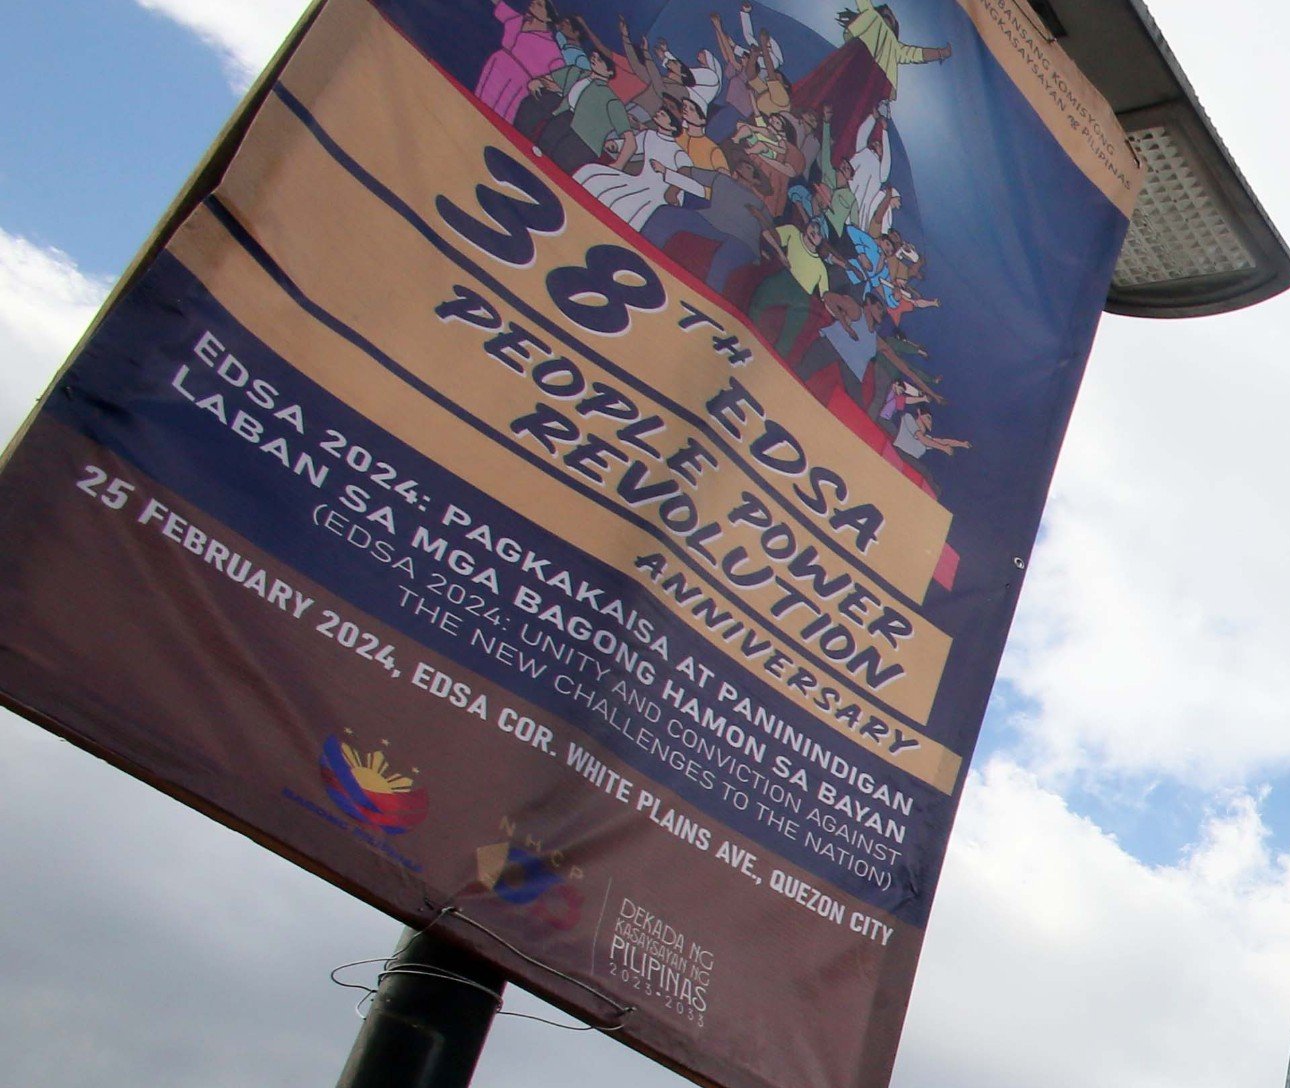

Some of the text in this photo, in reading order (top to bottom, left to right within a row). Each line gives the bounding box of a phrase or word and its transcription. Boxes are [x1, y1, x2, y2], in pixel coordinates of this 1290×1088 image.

[1051, 71, 1115, 155] KOMISYONG
[1081, 128, 1132, 190] PILIPINAS
[194, 330, 914, 816] EDSA 2024: PAGKAKAISA AT PANININDIGAN
[435, 285, 914, 652] PEOPLE POWER
[511, 403, 906, 693] REVOLUTION
[708, 376, 885, 554] EDSA
[76, 463, 136, 512] 25
[137, 496, 315, 622] FEBRUARY
[315, 608, 402, 680] 2024,
[412, 662, 490, 724] EDSA
[498, 706, 558, 758] COR.
[566, 741, 633, 802] WHITE
[636, 790, 713, 853] PLAINS
[769, 868, 846, 925] QUEZON
[849, 914, 894, 947] CITY
[171, 364, 906, 844] LABAN SA MGA BAGONG HAMON SA BAYAN
[312, 503, 903, 867] (EDSA 2024: UNITY AND CONVICTION AGAINST
[634, 552, 921, 759] ANNIVERSARY
[398, 585, 893, 892] THE NEW CHALLENGES TO THE NATION)
[610, 934, 707, 1012] PILIPINAS
[615, 917, 710, 987] KASAYSAYAN NG
[620, 897, 714, 971] DEKADA NG
